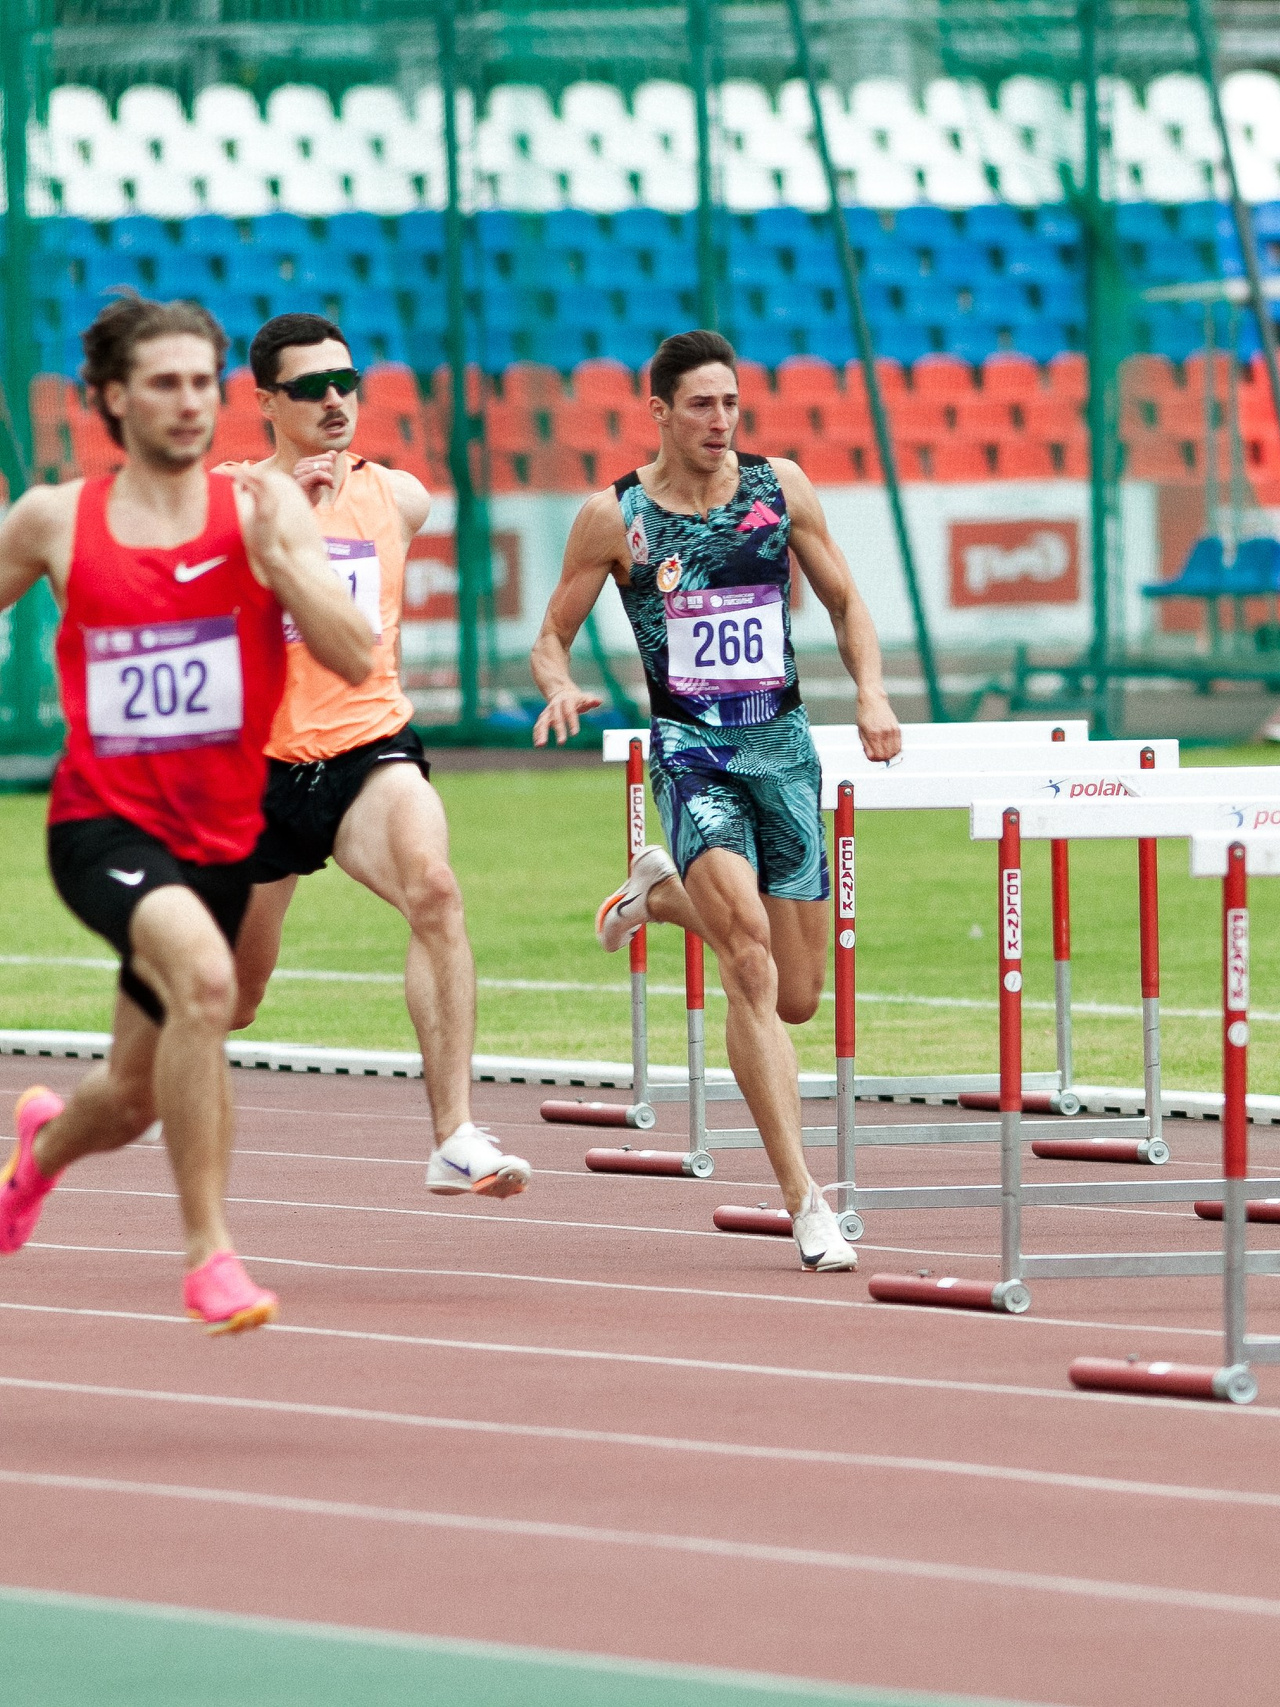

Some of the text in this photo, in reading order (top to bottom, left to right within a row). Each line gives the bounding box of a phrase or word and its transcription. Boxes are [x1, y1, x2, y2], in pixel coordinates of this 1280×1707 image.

[692, 617, 764, 668] 266
[120, 659, 210, 720] 202
[633, 786, 644, 848] POLANIK
[841, 839, 854, 911] POLANIK
[1006, 872, 1019, 951] POLANIK
